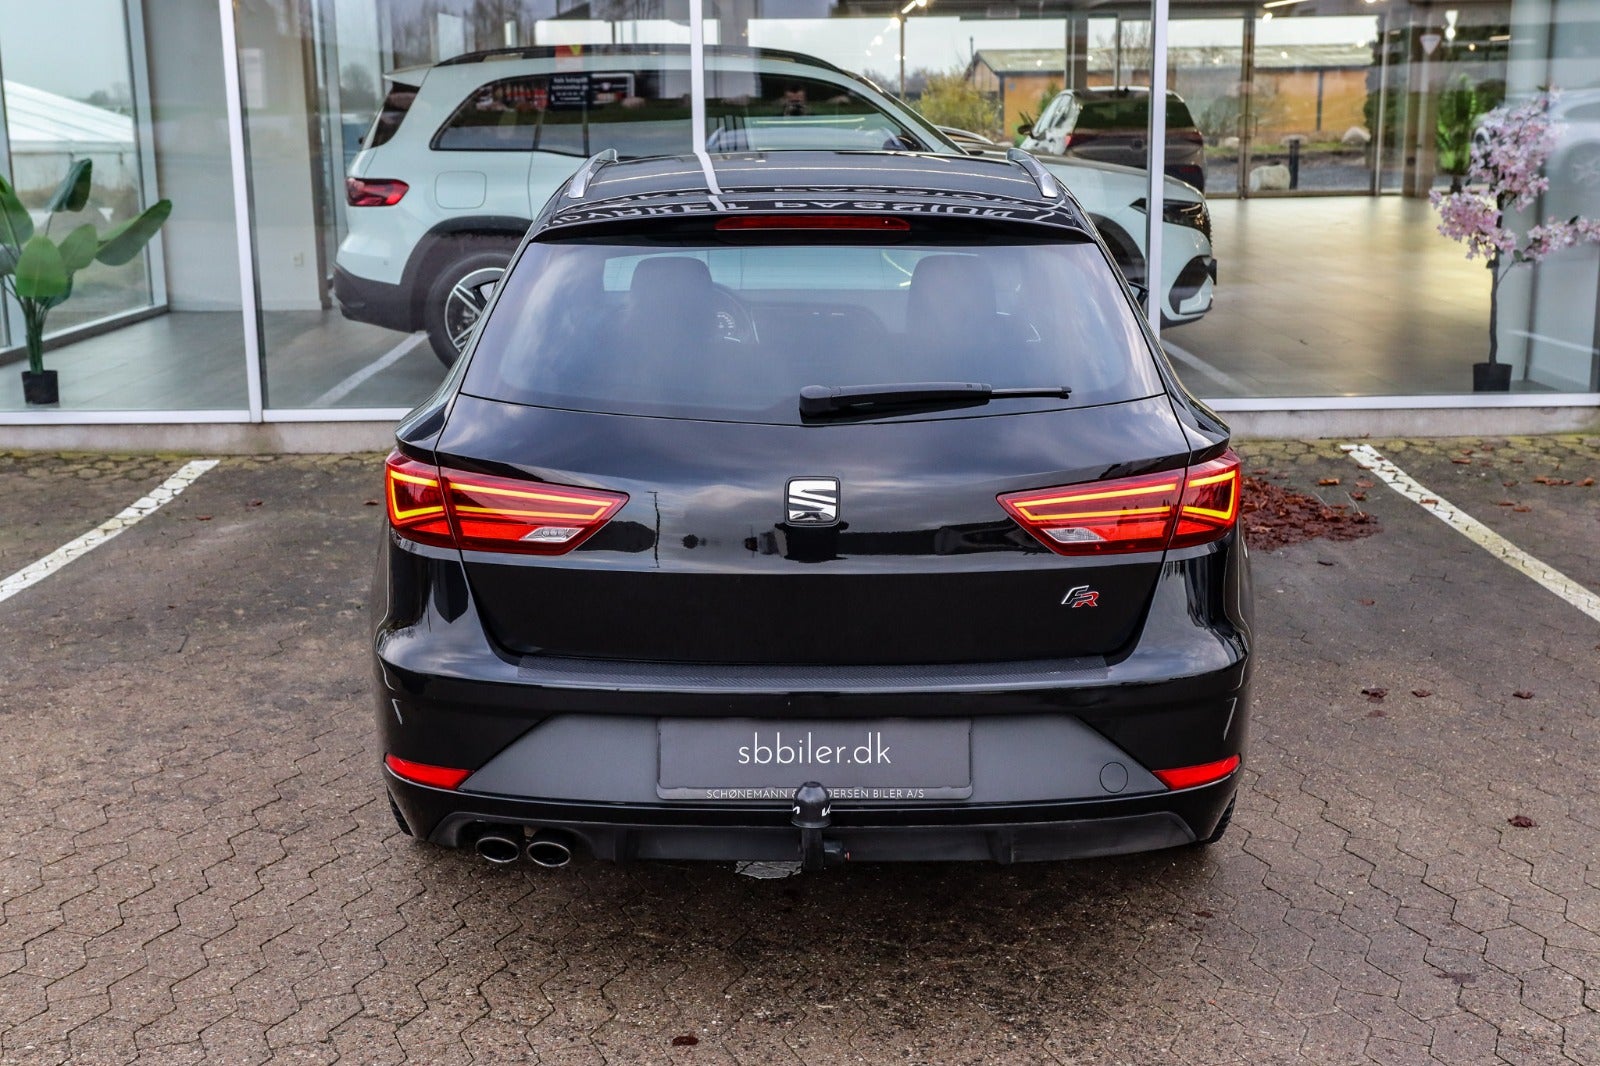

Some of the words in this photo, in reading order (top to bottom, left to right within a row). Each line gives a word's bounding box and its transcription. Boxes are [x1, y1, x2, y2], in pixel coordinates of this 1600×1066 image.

[1061, 585, 1099, 608] FR
[737, 731, 892, 764] sbbiler.dk
[706, 789, 788, 799] SCHØNEMANN
[826, 788, 869, 799] DERSEN
[873, 788, 903, 799] BILER
[906, 788, 925, 799] A/S
